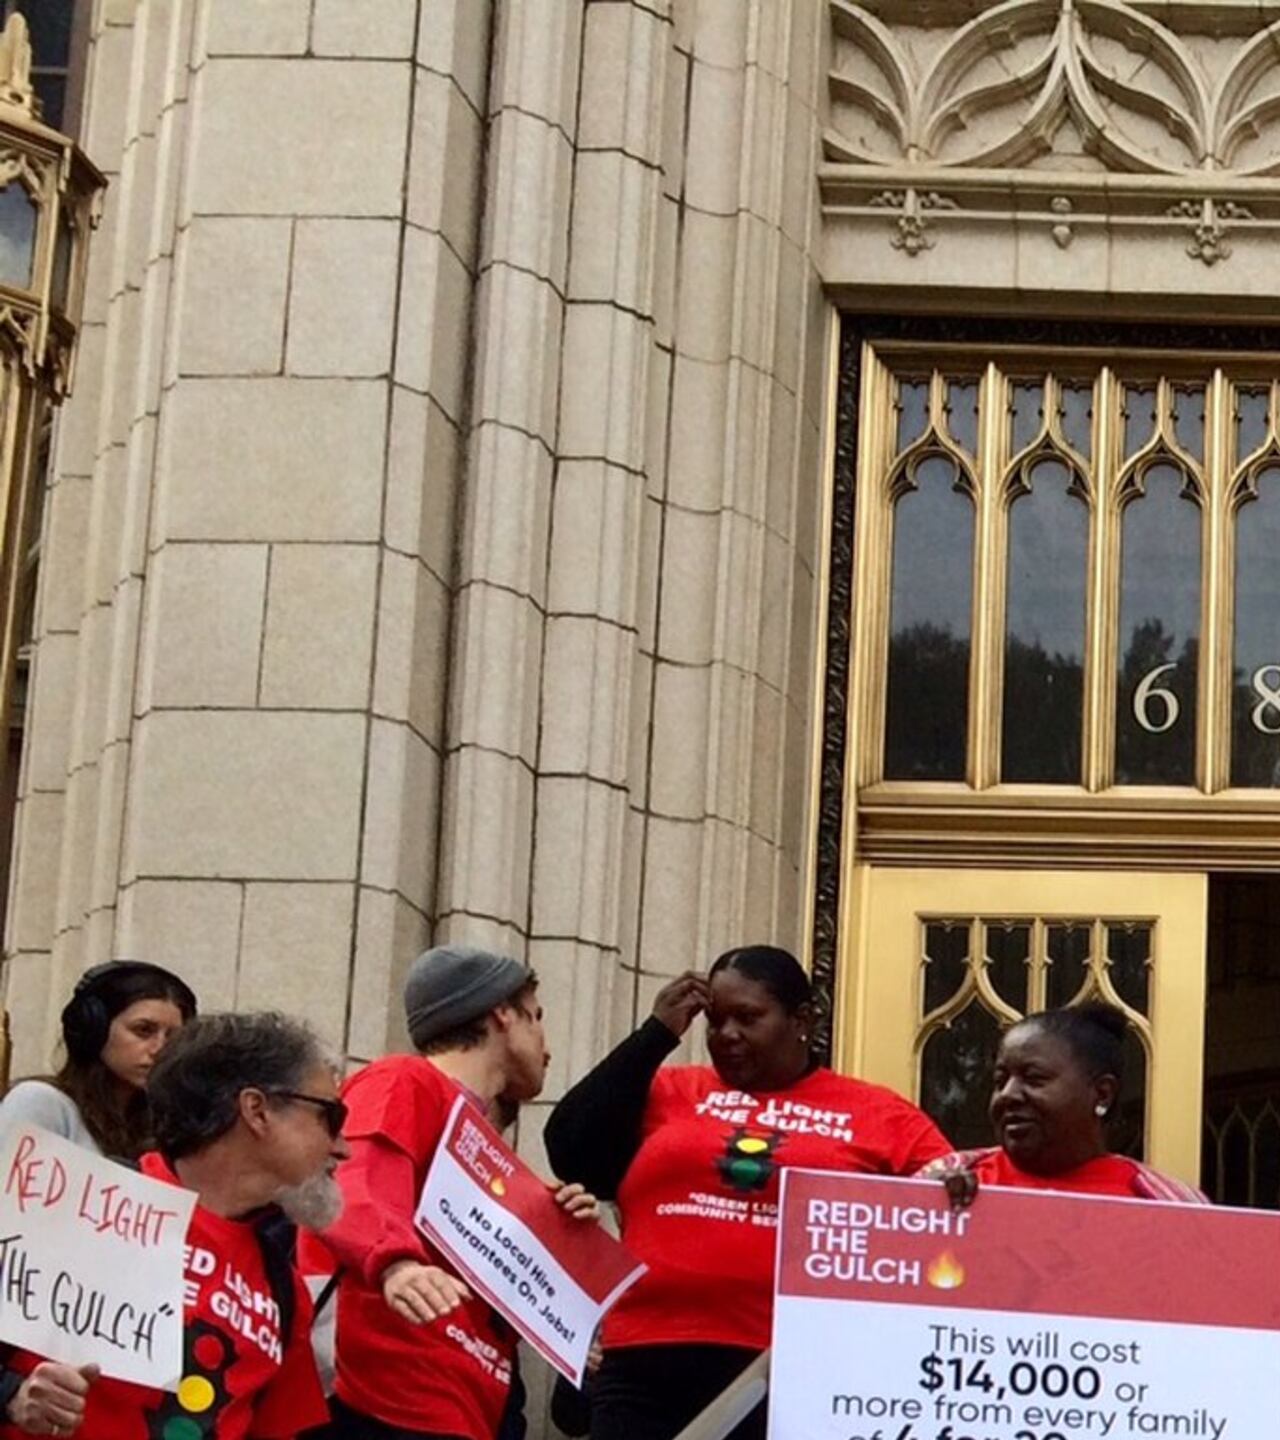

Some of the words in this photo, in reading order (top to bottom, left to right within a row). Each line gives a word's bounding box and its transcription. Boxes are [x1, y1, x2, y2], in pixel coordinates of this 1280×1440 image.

[694, 1103, 748, 1124] THE
[756, 1112, 854, 1142] GULCH
[767, 1098, 852, 1126] LIGHT
[5, 1135, 67, 1213] RED
[79, 1174, 178, 1247] LIGHT
[656, 1204, 748, 1224] COMMUNITY
[807, 1199, 971, 1237] REDLIGHT
[468, 1206, 492, 1233] No
[493, 1226, 533, 1270] Local
[530, 1265, 556, 1299] Hire
[806, 1226, 867, 1255] THE
[0, 1235, 41, 1320] THE
[438, 1198, 517, 1284] Guarantees
[518, 1281, 539, 1307] On
[538, 1305, 577, 1343] Jobs!
[804, 1254, 920, 1285] GULCH
[210, 1291, 282, 1366] GULCH
[929, 1323, 996, 1355] This
[1007, 1331, 1060, 1359] will
[1069, 1337, 1142, 1365] cost
[918, 1353, 1102, 1401] $14,000
[1115, 1380, 1149, 1404] or
[831, 1393, 924, 1421] more
[934, 1396, 1012, 1426] from
[1023, 1402, 1117, 1437] every
[1127, 1407, 1228, 1440] family
